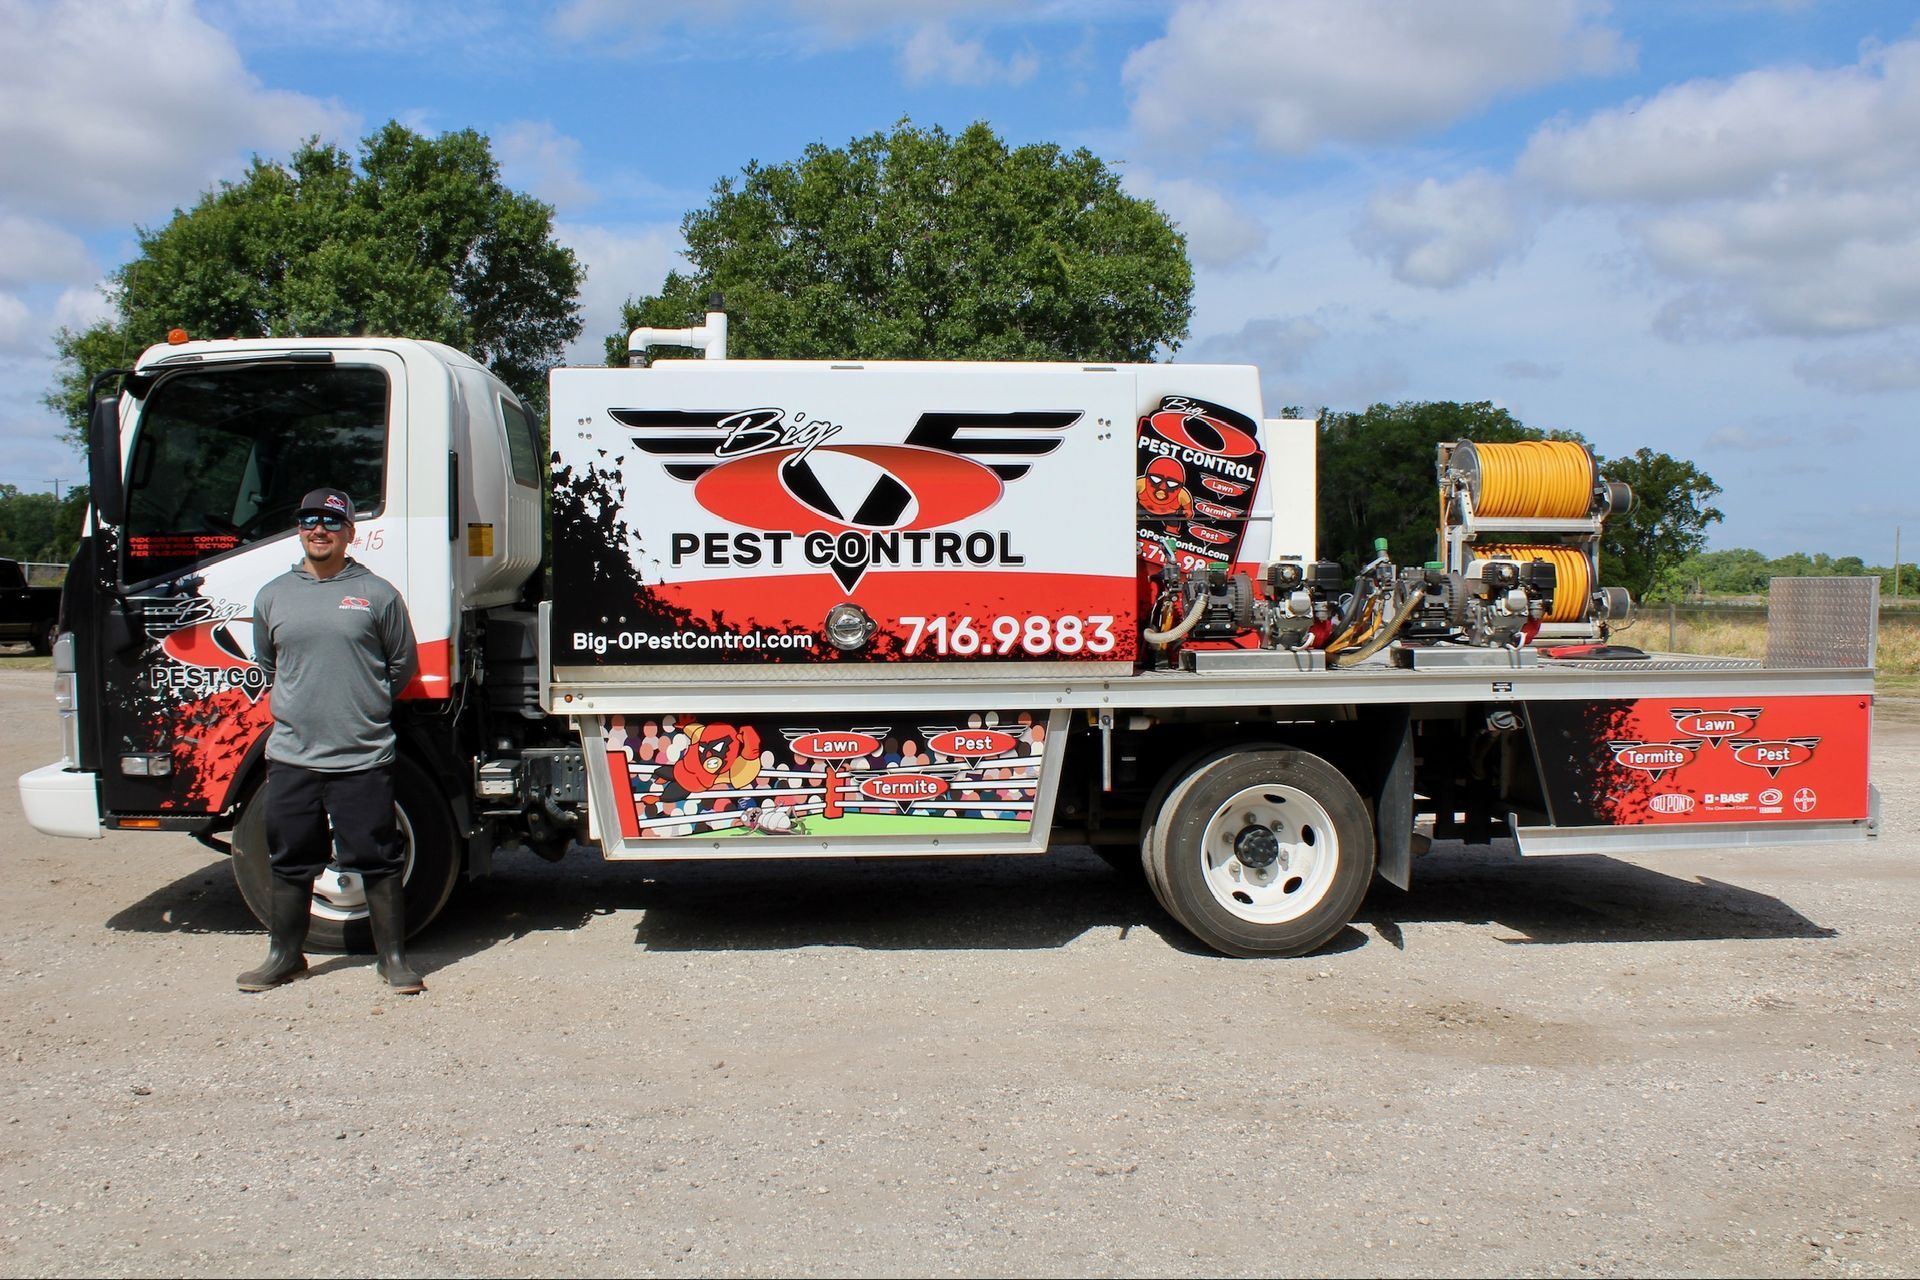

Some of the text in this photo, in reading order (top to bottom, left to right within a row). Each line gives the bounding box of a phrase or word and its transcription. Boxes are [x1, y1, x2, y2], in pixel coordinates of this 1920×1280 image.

[1162, 397, 1208, 421] Big
[714, 407, 843, 467] Big
[1138, 435, 1256, 482] PEST CONTROL
[1212, 481, 1234, 494] Lawn
[1201, 505, 1232, 519] Termite
[1200, 529, 1219, 541] Pest
[671, 530, 1026, 567] PEST CONTROL
[175, 596, 248, 632] Big
[572, 630, 813, 654] Big-OPestControl.com
[899, 614, 1116, 655] 716.9883
[151, 666, 222, 688] PEST
[1696, 718, 1735, 732] Lawn
[812, 736, 859, 754] Lawn
[953, 734, 993, 751] Pest
[1627, 750, 1684, 764] Termite
[1757, 747, 1790, 761] Pest
[872, 778, 938, 796] Termite
[1720, 793, 1749, 804] BASF
